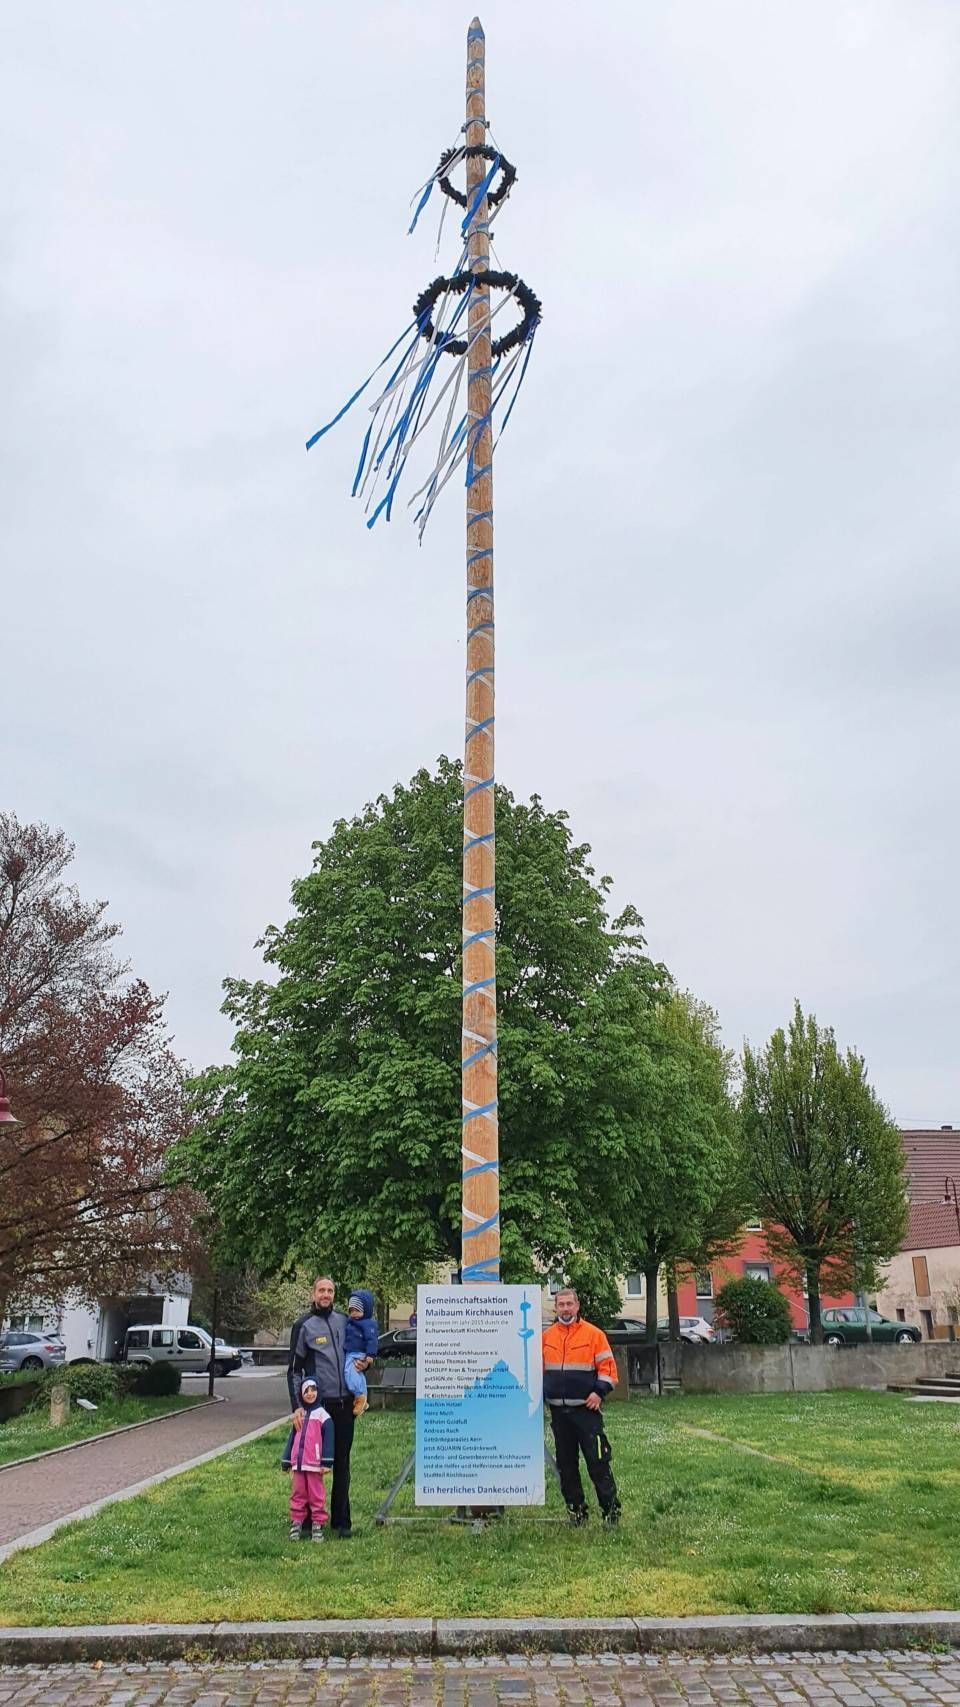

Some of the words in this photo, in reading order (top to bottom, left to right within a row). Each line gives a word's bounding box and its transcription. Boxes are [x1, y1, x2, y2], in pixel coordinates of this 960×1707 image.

[426, 1296, 508, 1304] Gemeinschaftsaktion
[426, 1309, 463, 1317] Maibaum
[466, 1309, 513, 1317] Kirchhausen
[423, 1486, 434, 1494] Ein
[437, 1486, 475, 1494] herzliches
[478, 1486, 527, 1494] Dankeschön!
